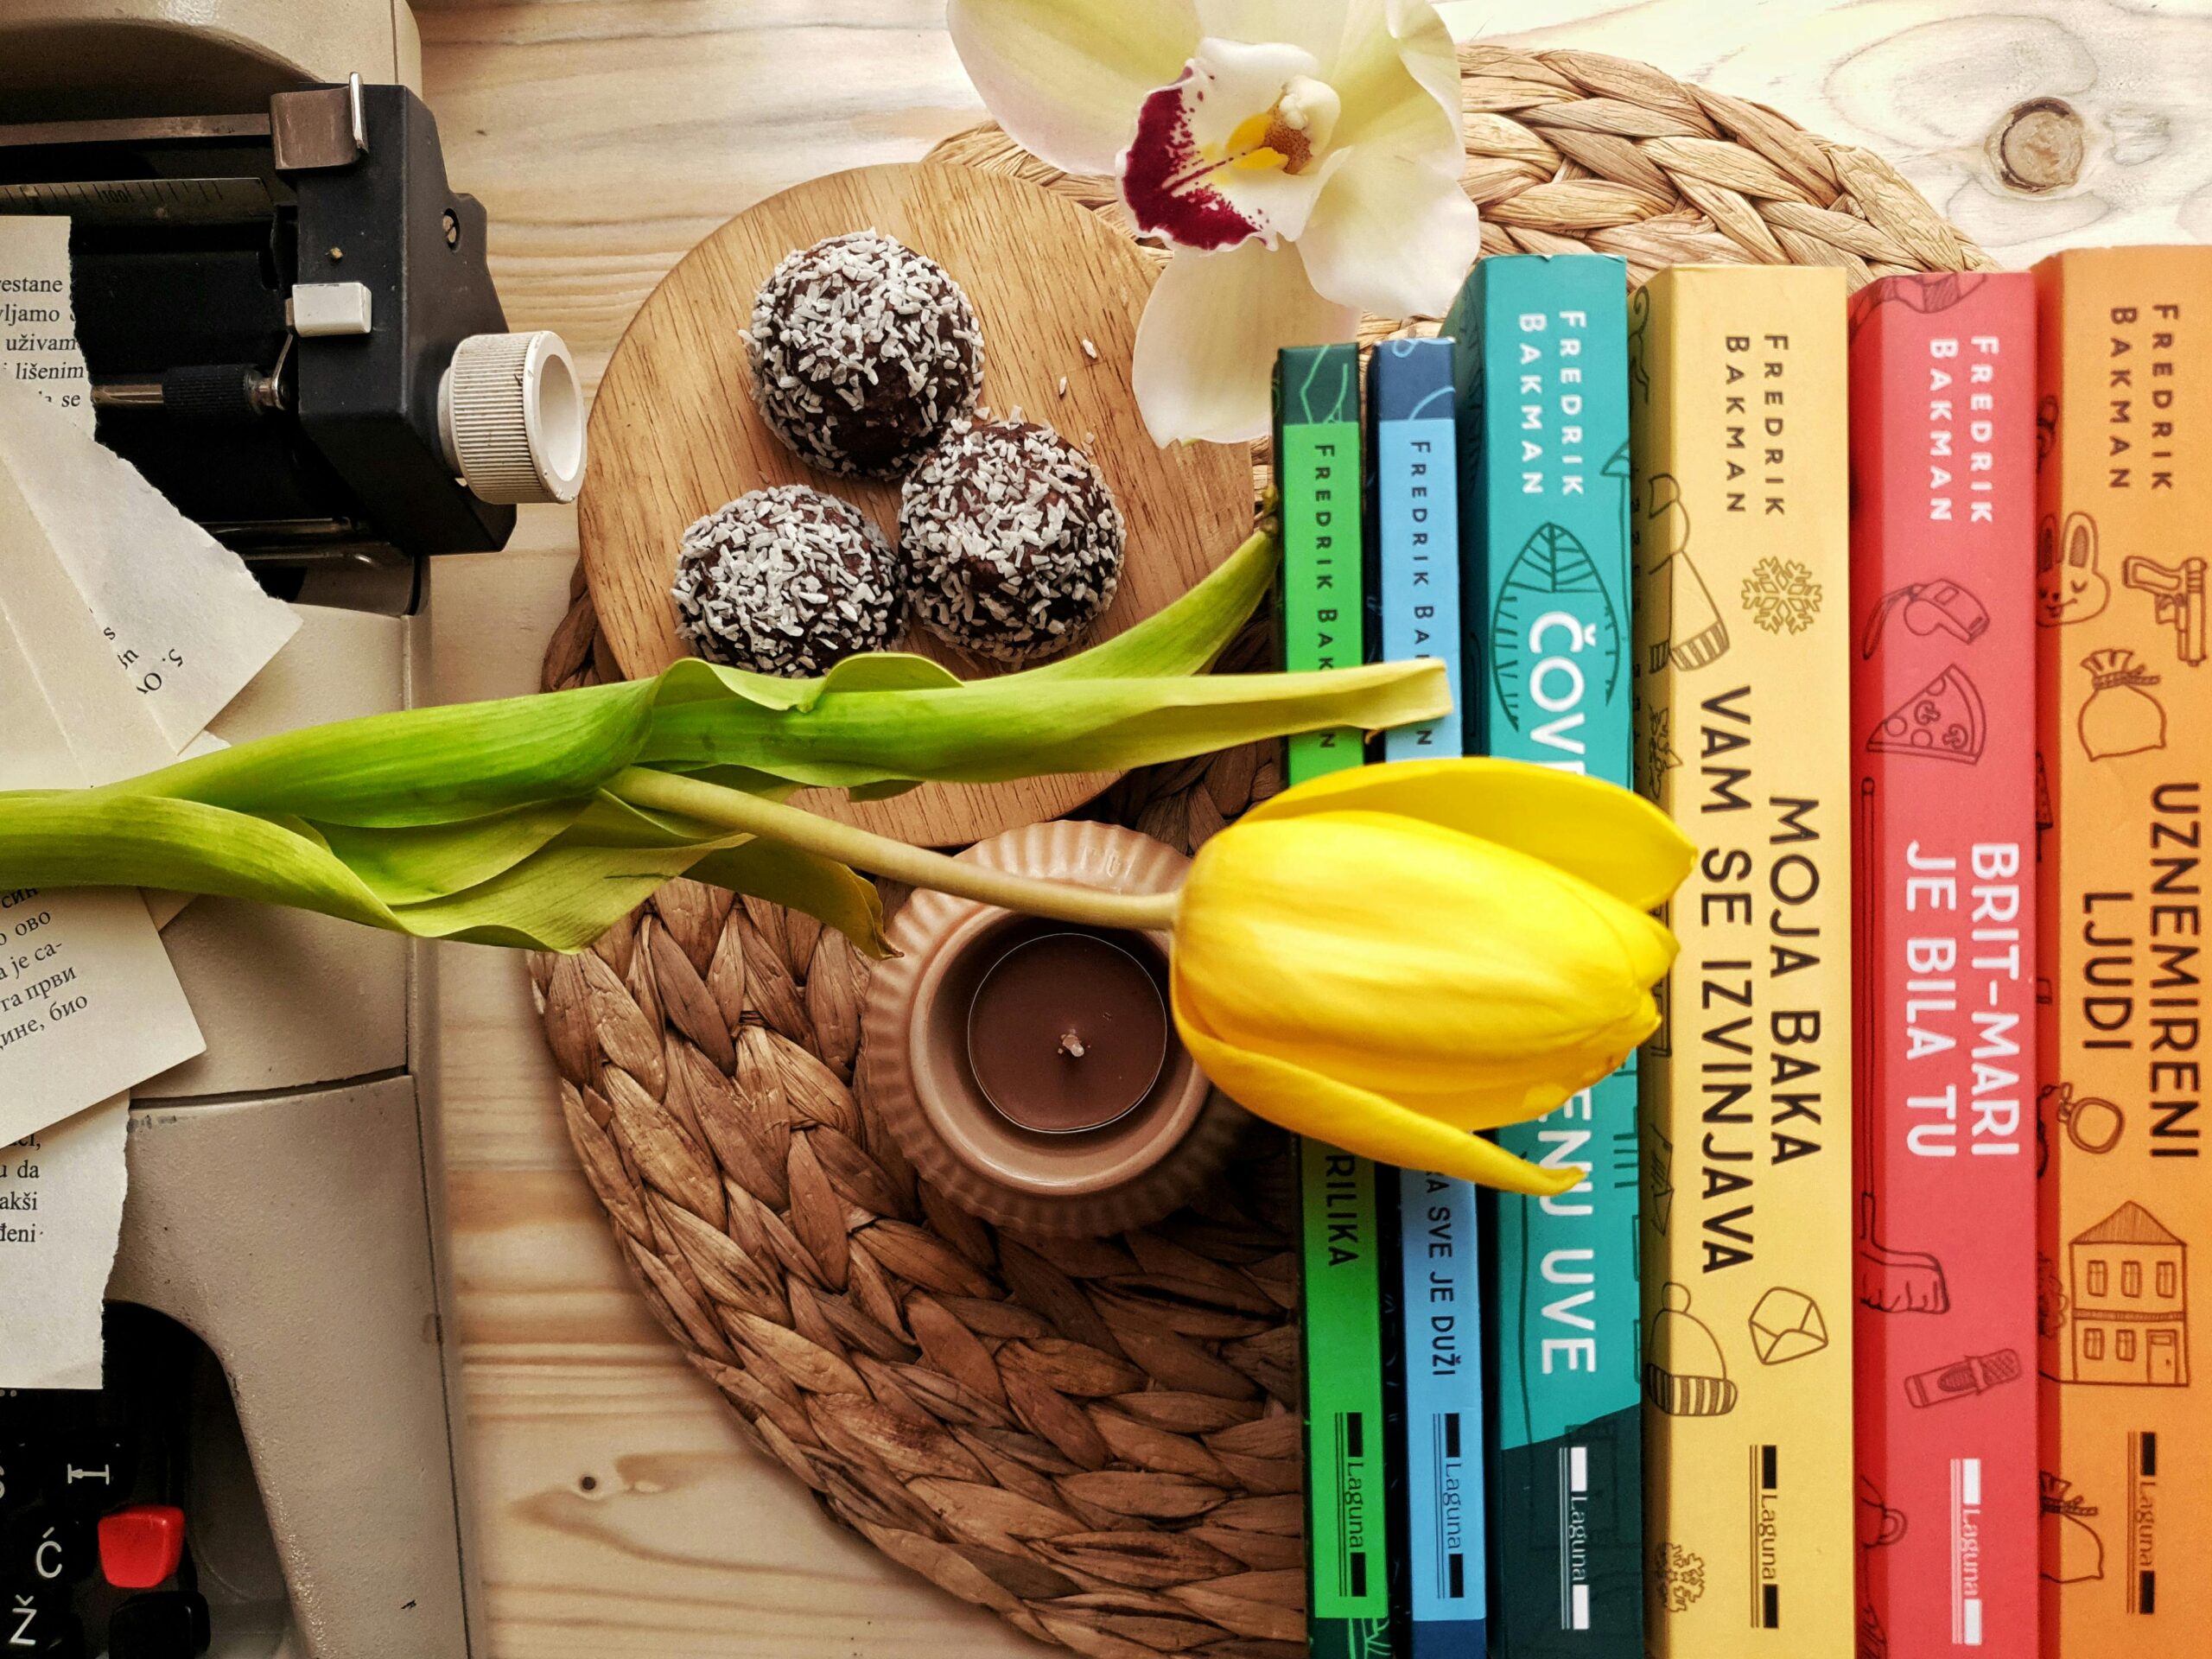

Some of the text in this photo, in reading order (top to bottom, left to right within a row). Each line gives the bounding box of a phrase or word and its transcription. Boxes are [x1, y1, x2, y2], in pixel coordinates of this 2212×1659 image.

[6, 334, 81, 351] uživam
[16, 361, 84, 380] lišenim
[61, 394, 81, 407] se
[1519, 314, 1548, 493] BAKMAN
[1559, 311, 1586, 495] FREDRIK
[1726, 336, 1751, 512] BAKMAN
[1764, 334, 1789, 515] FREDRIK
[1929, 339, 1959, 520] BAKMAN
[1970, 336, 1999, 522] FREDRIK
[2109, 307, 2138, 488] BAKMAN
[2152, 304, 2179, 490] FREDRIK
[1410, 442, 1431, 586] FREDRIK
[1314, 444, 1338, 749] FREDRIK BAKN
[162, 648, 184, 668] 5.
[10, 956, 30, 979] је
[34, 942, 63, 962] са-
[15, 912, 52, 937] ово
[25, 966, 78, 1001] први
[1700, 685, 1754, 1274] VAM SE IZVINJAVA
[1769, 797, 1821, 1166] MOJA BAKA
[1906, 841, 1957, 1157] JE BILA TU
[1971, 843, 2020, 1154] BRIT-MARI
[2082, 893, 2133, 1049] LJUDI
[2150, 783, 2200, 1158] UZNEMIRENI
[0, 995, 88, 1050] ине, био
[16, 1159, 40, 1179] da
[1536, 1088, 1594, 1217] ENU
[0, 1191, 38, 1211] akši
[1325, 1154, 1358, 1266] RILIKA
[1427, 1206, 1452, 1258] SVE
[1429, 1271, 1454, 1303] JE
[1541, 1249, 1596, 1374] UVE
[1430, 1315, 1461, 1376] DUŽI
[1344, 1461, 1365, 1549] Laguna
[1442, 1461, 1461, 1550] Laguna
[1568, 1495, 1588, 1583] Laguna
[1758, 1494, 1778, 1580] Laguna
[2135, 1480, 2157, 1567] Laguna
[35, 1526, 63, 1579] Ć
[1960, 1509, 1981, 1598] Laguna
[8, 1593, 38, 1646] Ž
